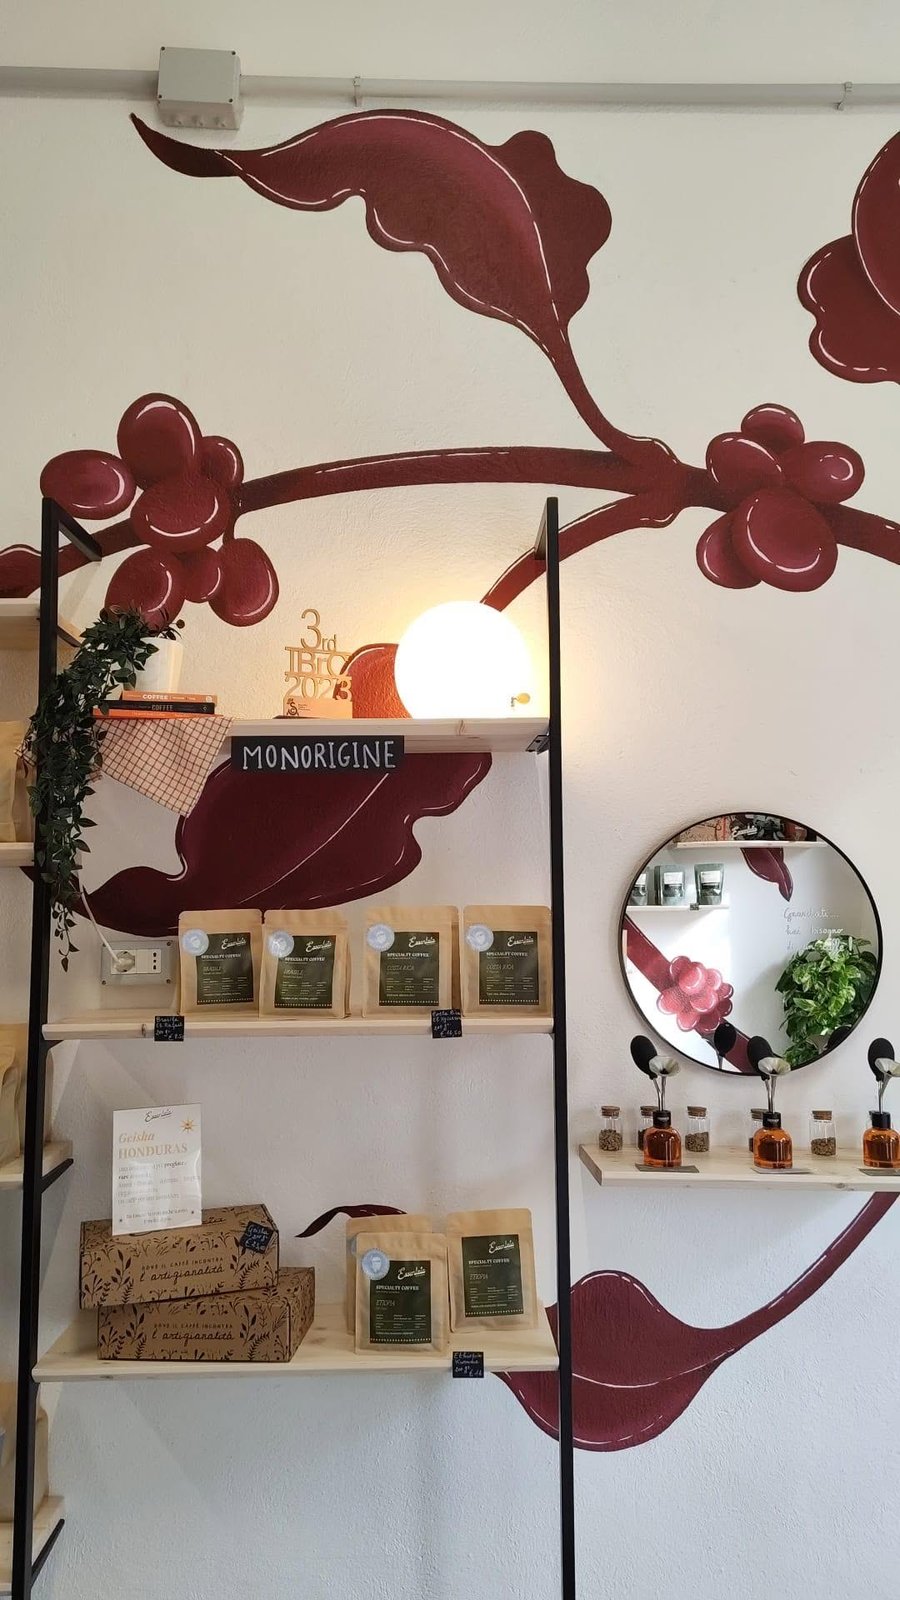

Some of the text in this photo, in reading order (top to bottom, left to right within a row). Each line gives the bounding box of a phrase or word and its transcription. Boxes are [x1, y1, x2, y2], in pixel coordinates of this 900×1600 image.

[300, 608, 337, 652] 3rd
[284, 672, 352, 701] 2023
[242, 740, 396, 770] MONORIGINE
[119, 1131, 156, 1144] Geisha
[119, 1143, 188, 1159] HONDURAS
[192, 1257, 223, 1265] INCONTRA
